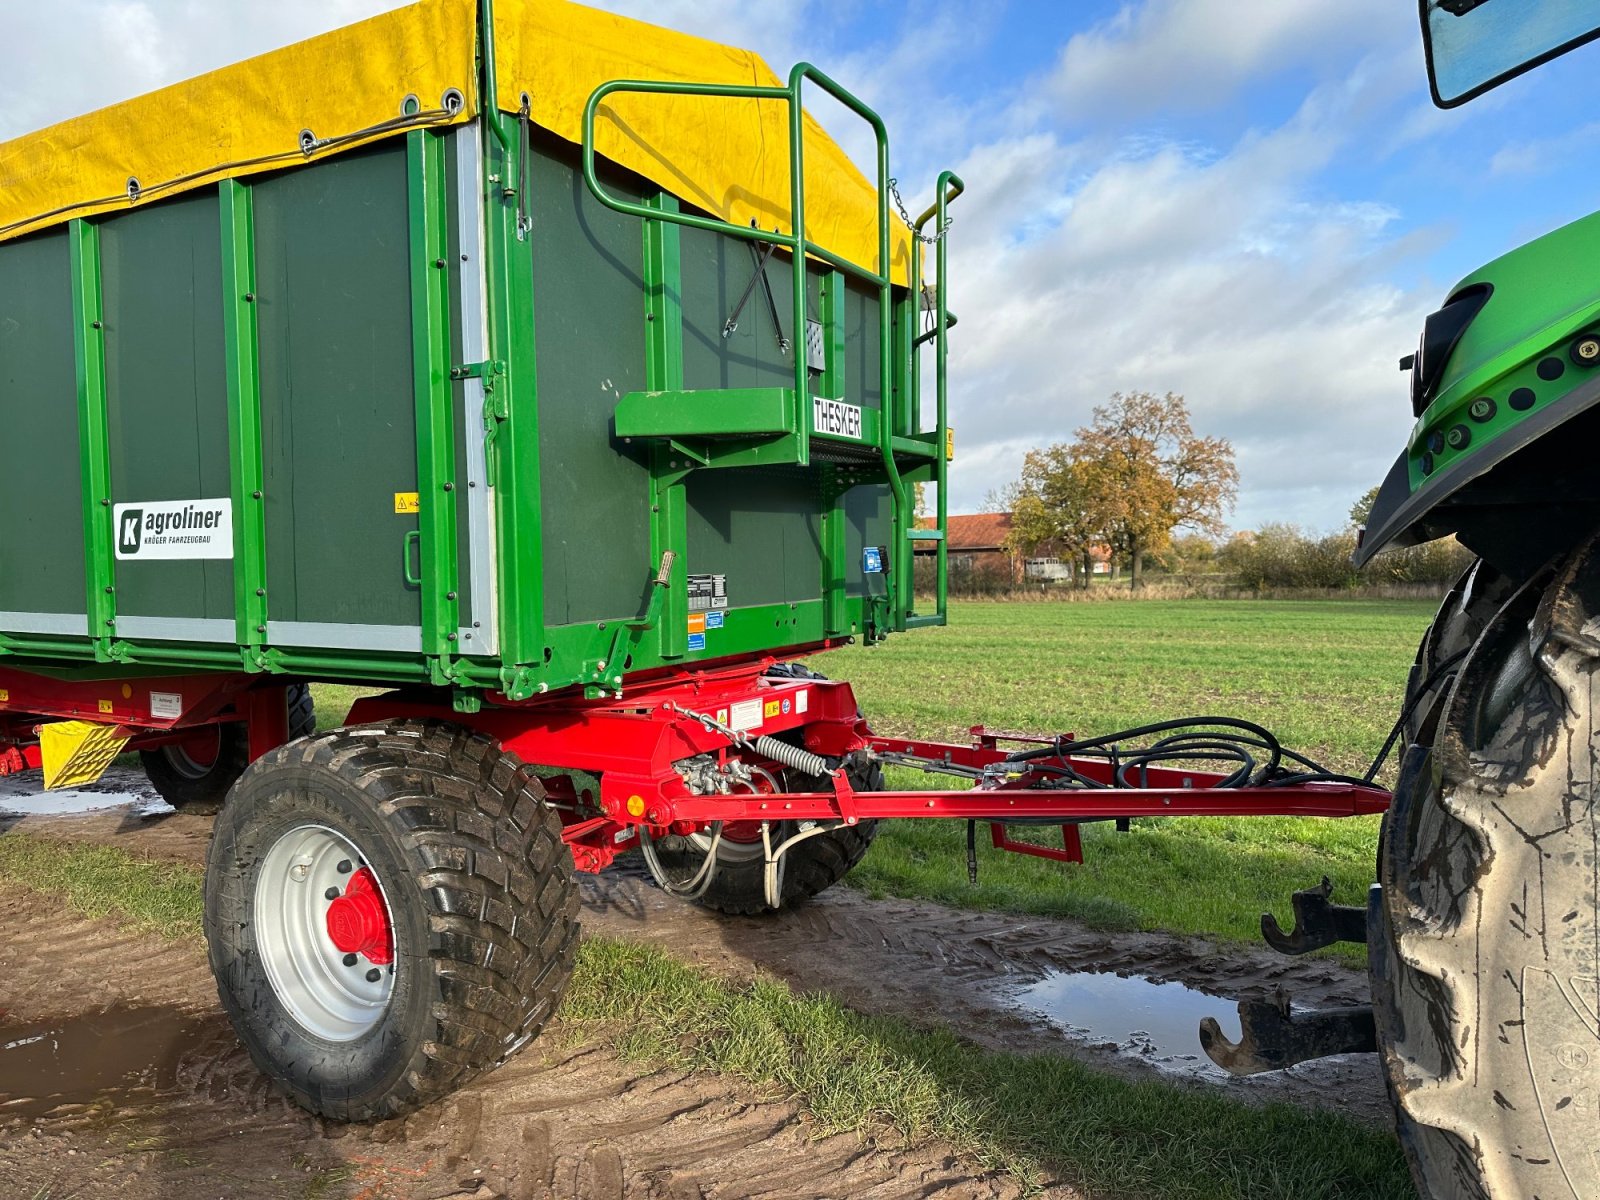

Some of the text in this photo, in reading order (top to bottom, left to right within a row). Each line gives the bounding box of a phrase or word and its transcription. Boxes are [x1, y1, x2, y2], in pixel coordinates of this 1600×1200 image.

[815, 399, 861, 437] THESKER
[123, 518, 139, 546] K
[145, 505, 223, 535] agroliner
[144, 535, 211, 545] KRÖGER FAHRZEUGBAU
